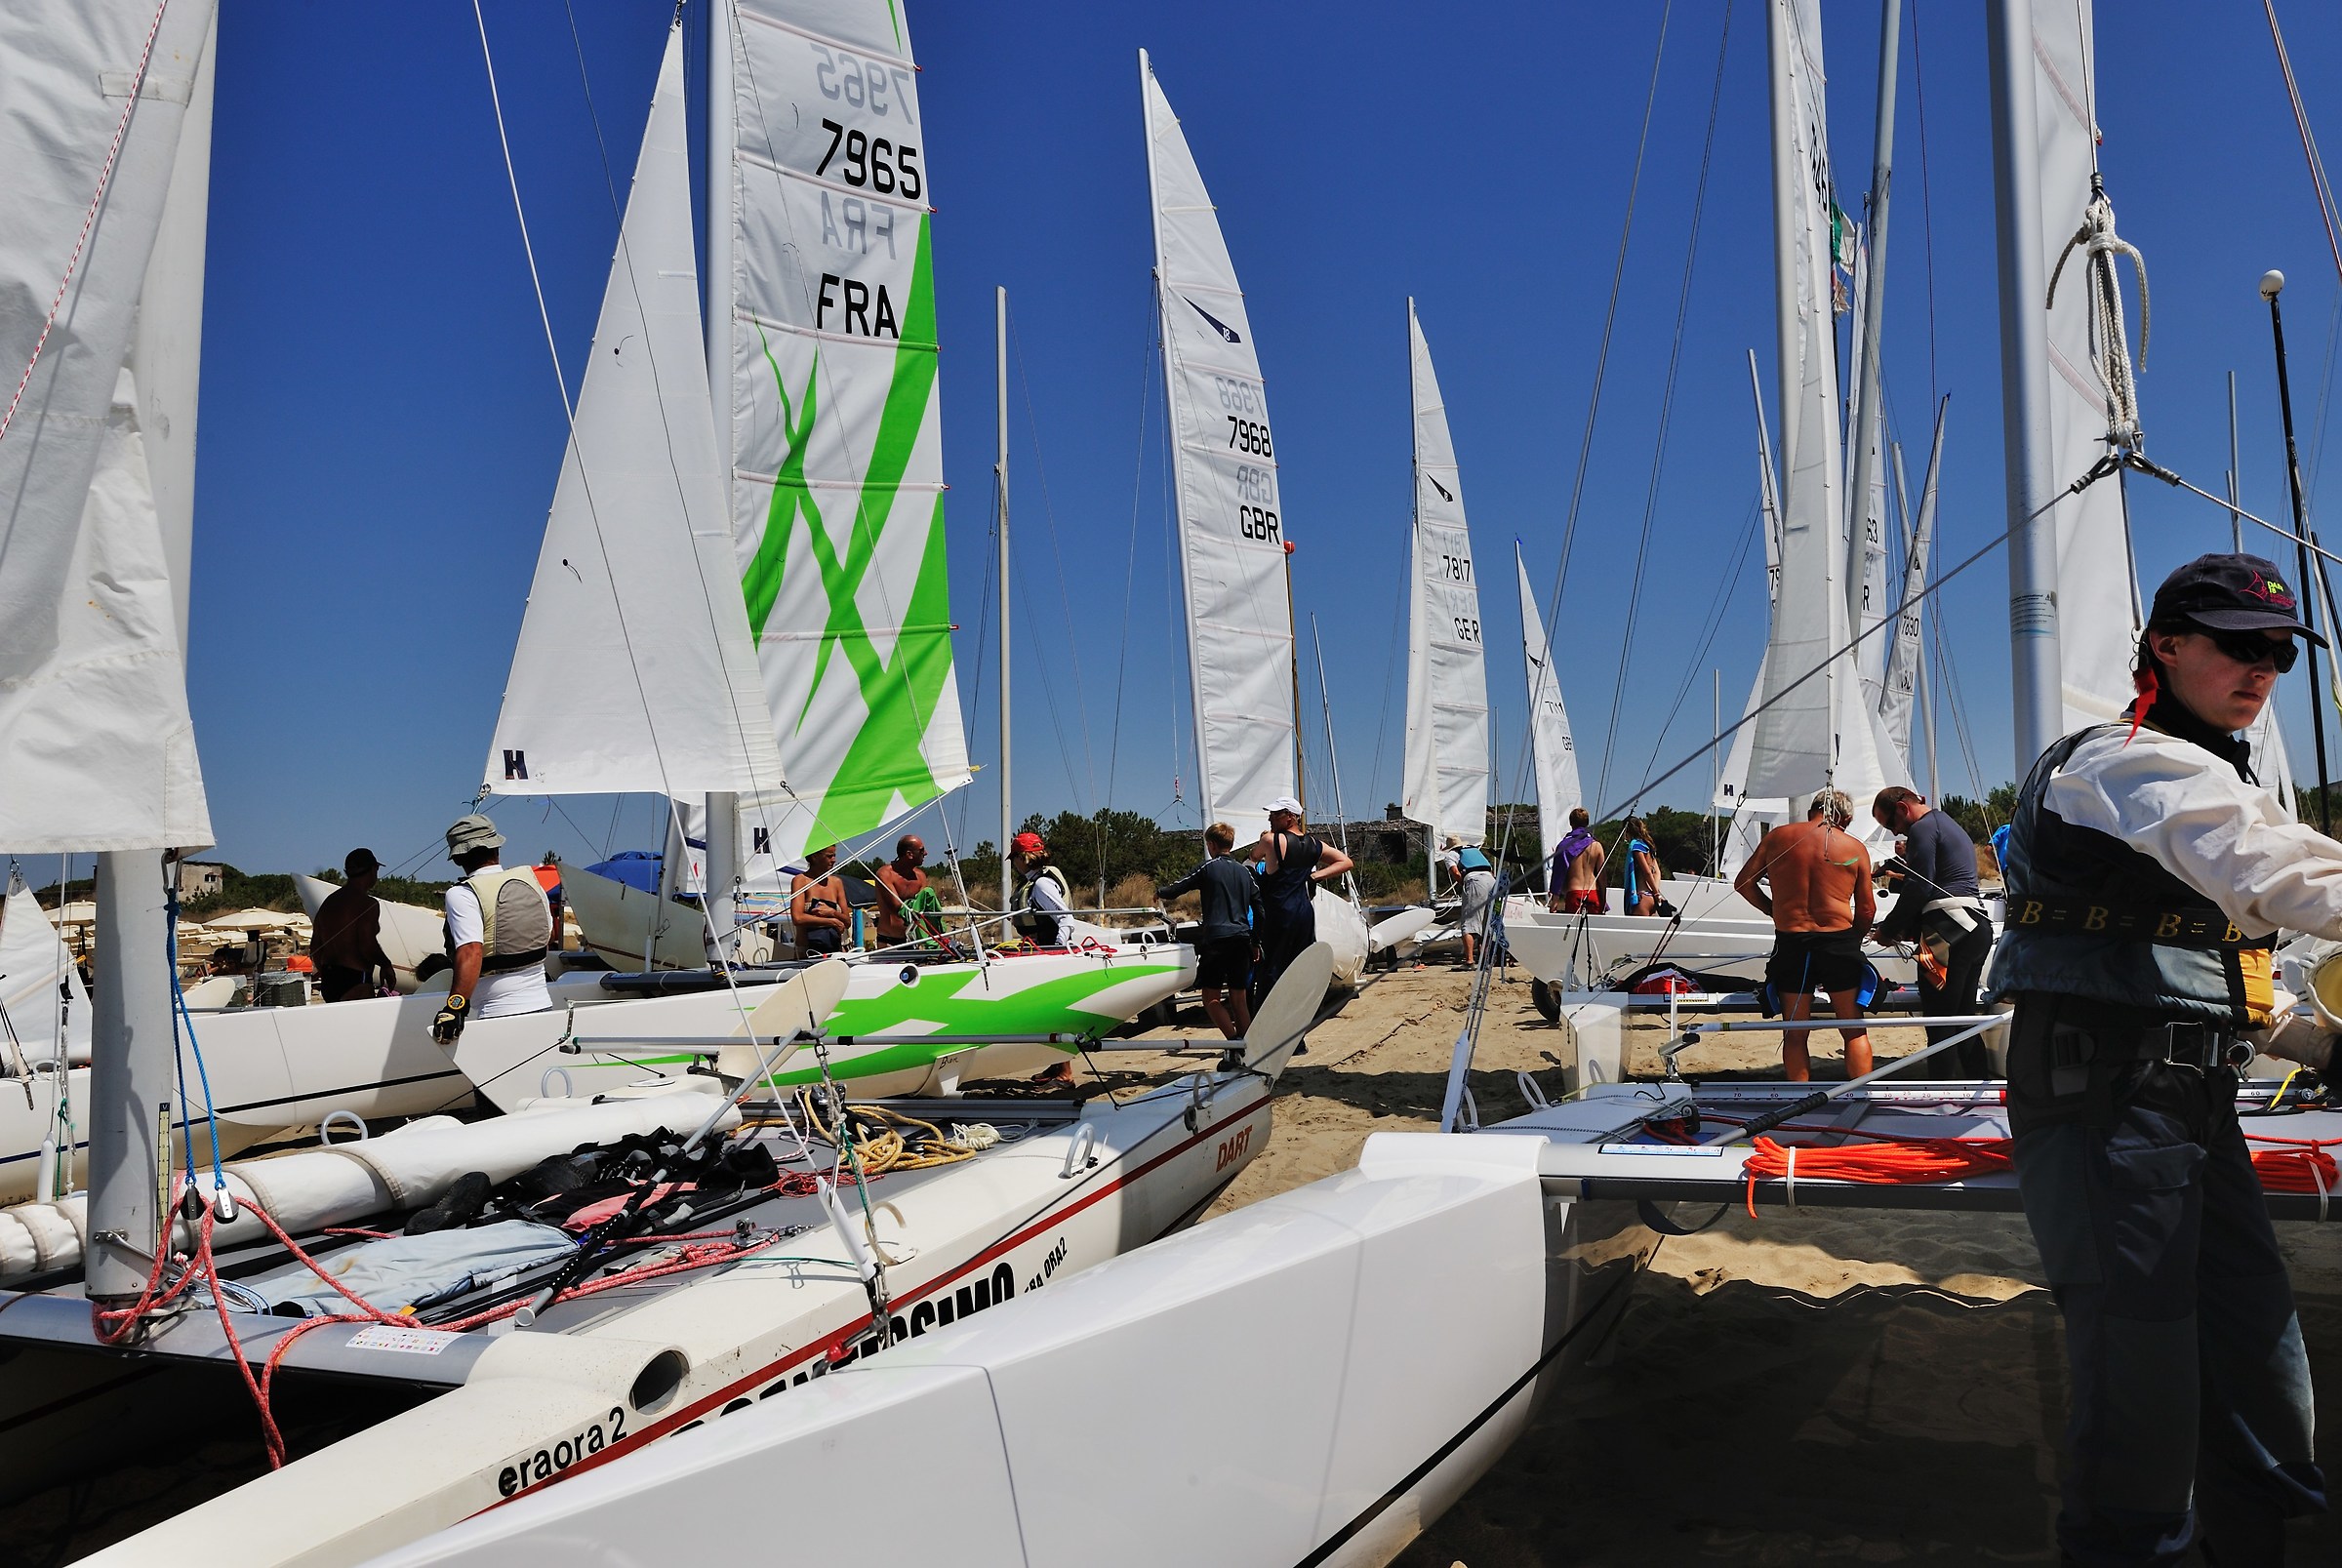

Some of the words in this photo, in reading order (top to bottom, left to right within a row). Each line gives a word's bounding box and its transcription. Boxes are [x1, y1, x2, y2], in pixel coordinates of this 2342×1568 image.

[816, 118, 921, 200] 7965
[817, 273, 900, 339] FRA
[1228, 415, 1272, 459] 7968
[1240, 504, 1280, 545] GBR
[1442, 555, 1471, 582] 7817
[1454, 617, 1481, 644] GER
[1216, 1124, 1253, 1173] DART
[1043, 1236, 1068, 1279] ORA2
[498, 1425, 605, 1497] eraora
[608, 1406, 627, 1444] 2
